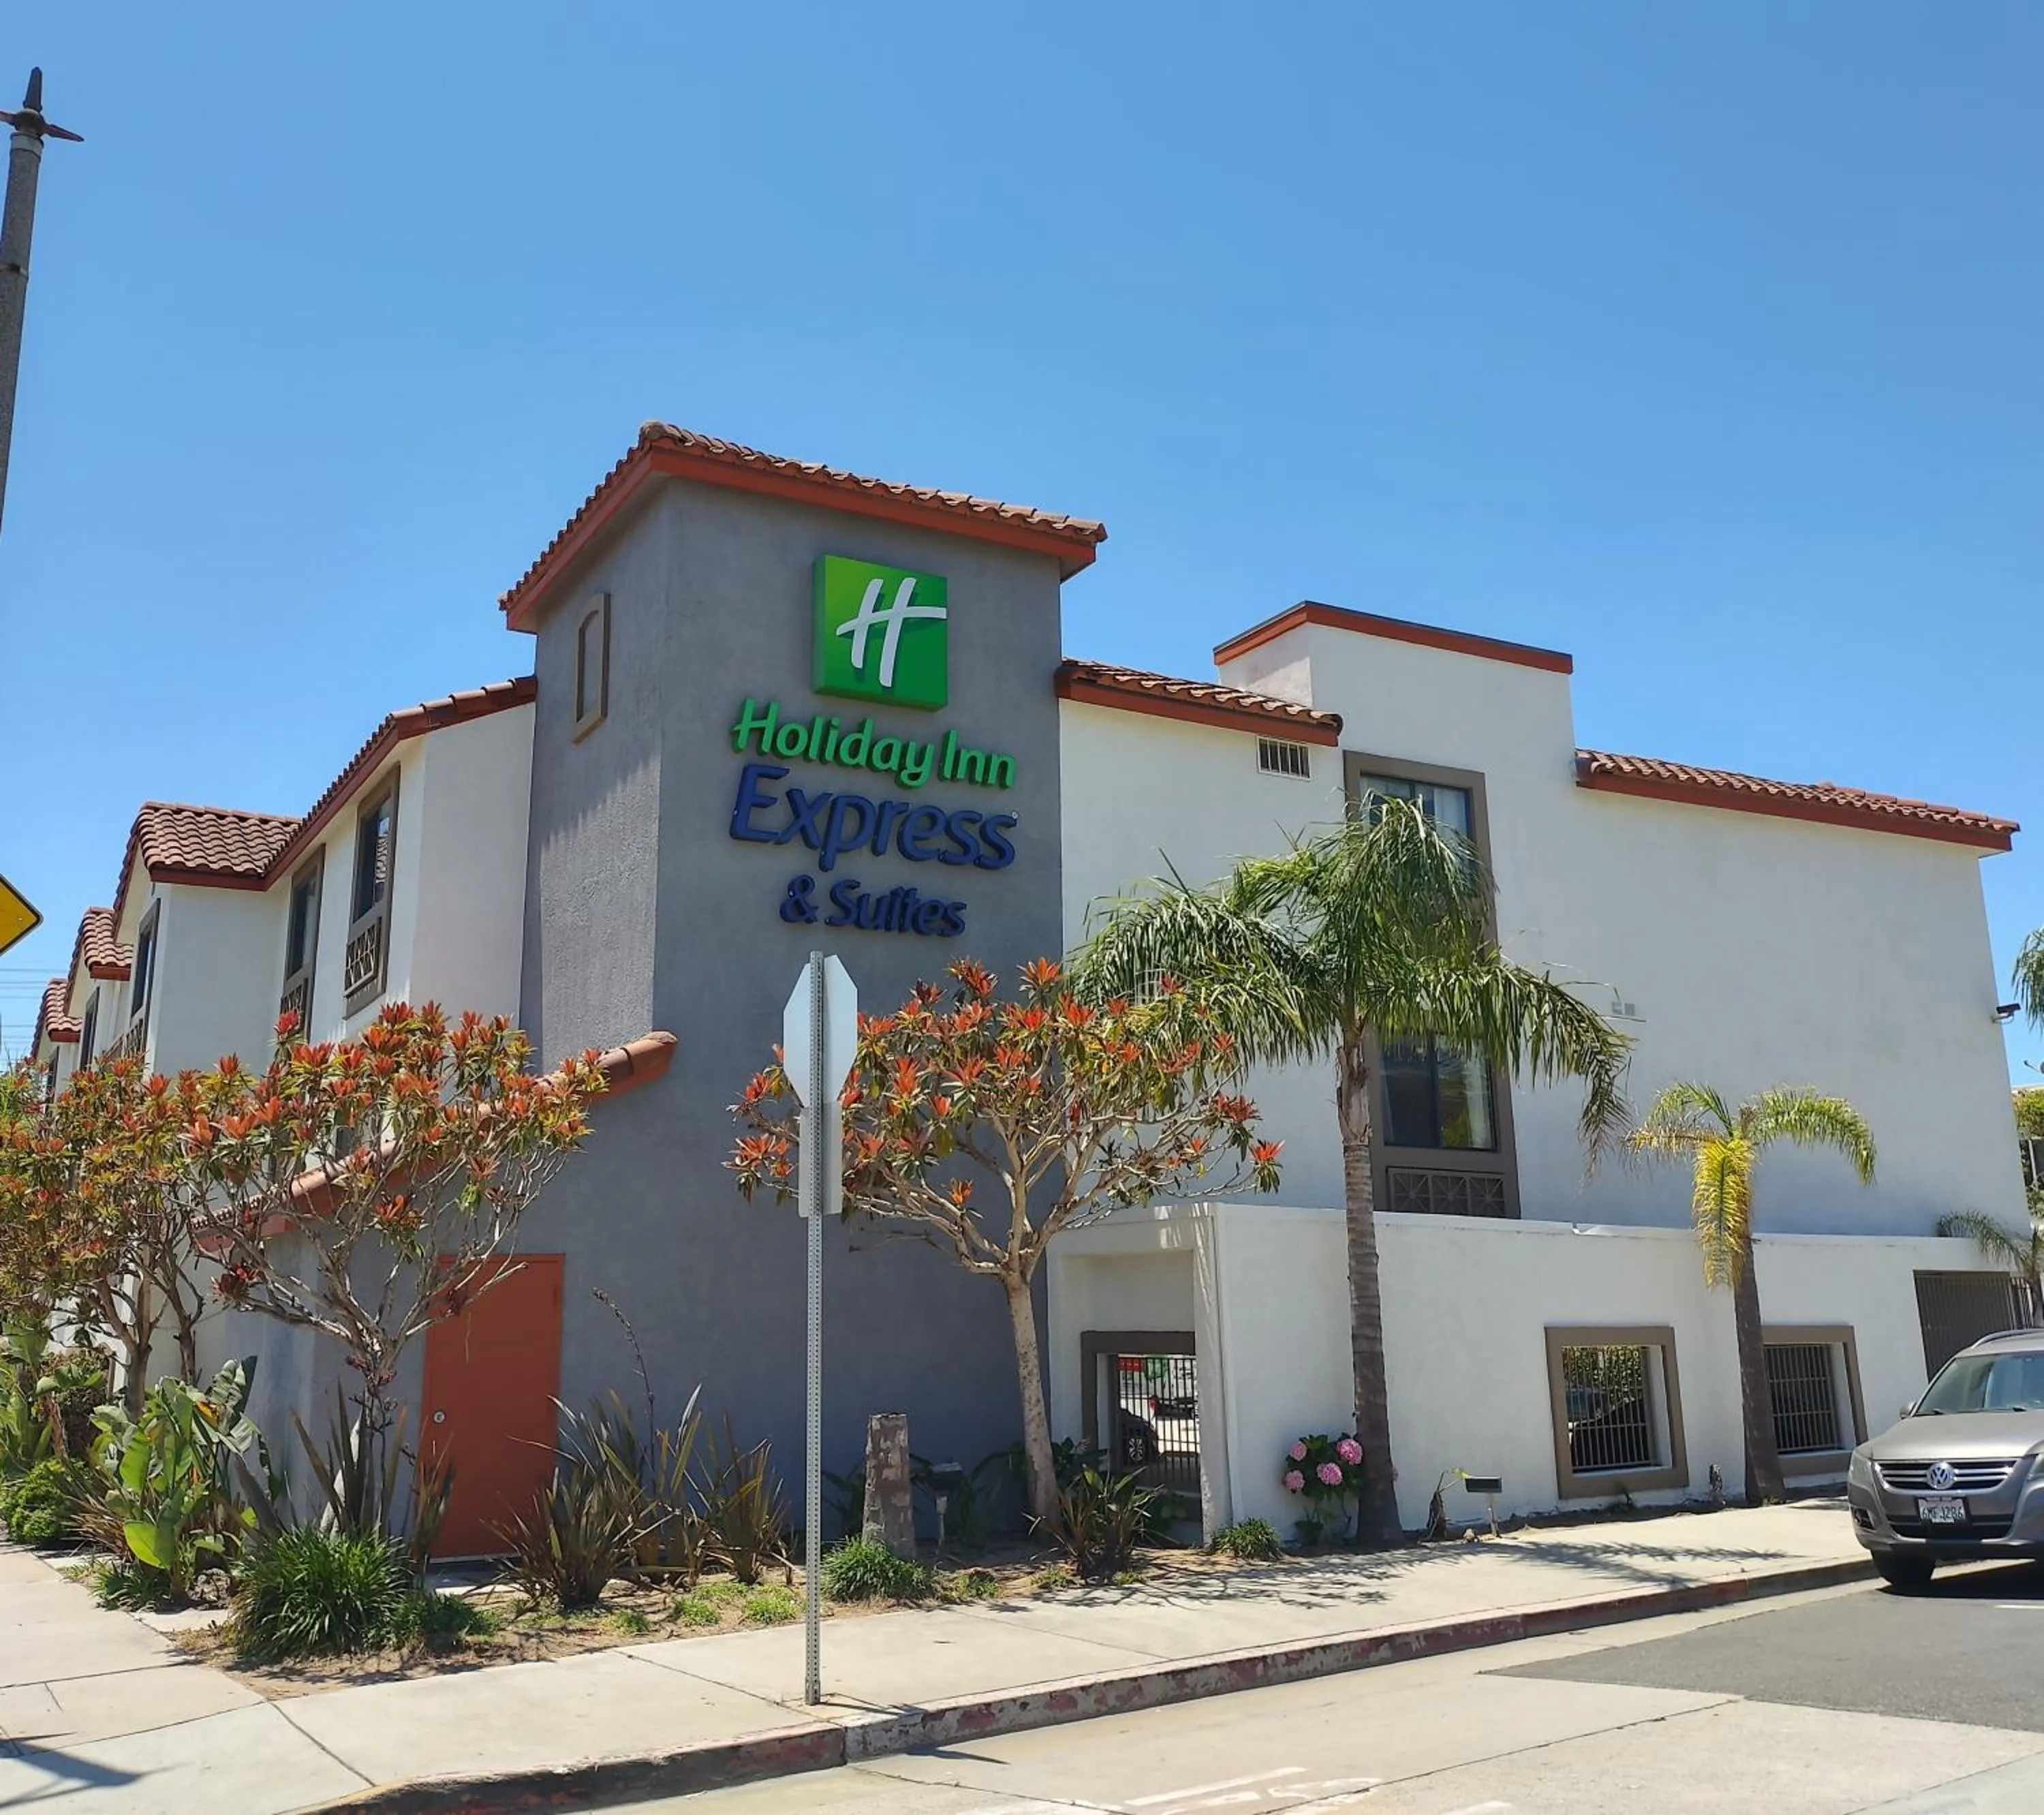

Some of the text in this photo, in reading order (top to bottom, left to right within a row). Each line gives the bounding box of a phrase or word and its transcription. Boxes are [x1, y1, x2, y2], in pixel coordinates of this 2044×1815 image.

[730, 698, 1016, 789] Holiday Inn
[729, 764, 1017, 872] Express
[779, 874, 967, 937] & Suites
